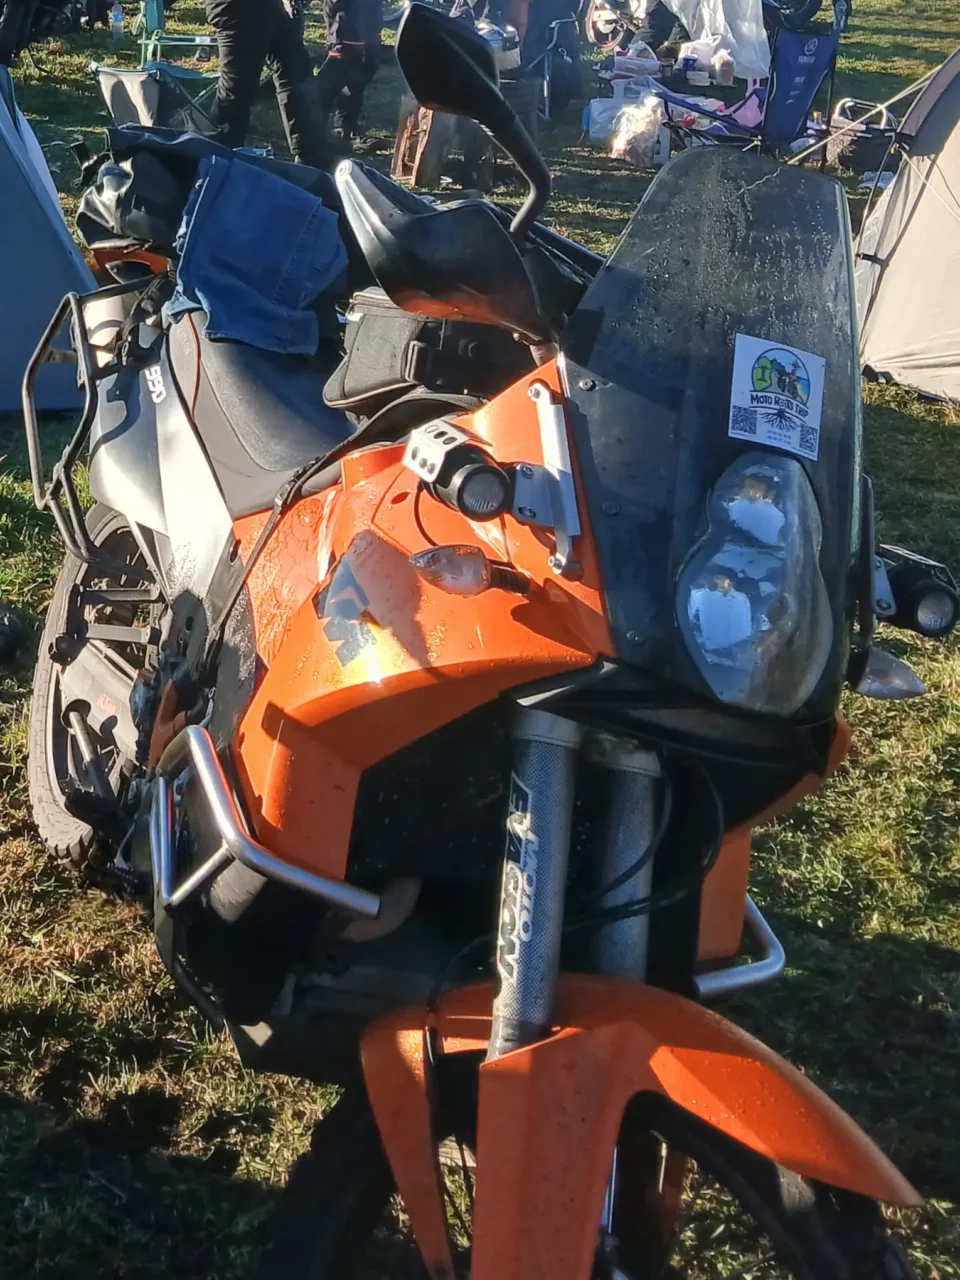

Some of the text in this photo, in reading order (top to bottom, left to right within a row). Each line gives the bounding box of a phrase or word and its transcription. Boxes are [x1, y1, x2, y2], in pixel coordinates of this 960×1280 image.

[144, 364, 167, 404] 990
[750, 393, 773, 405] MOTO
[795, 404, 809, 418] TRIP
[519, 832, 540, 942] MOTO
